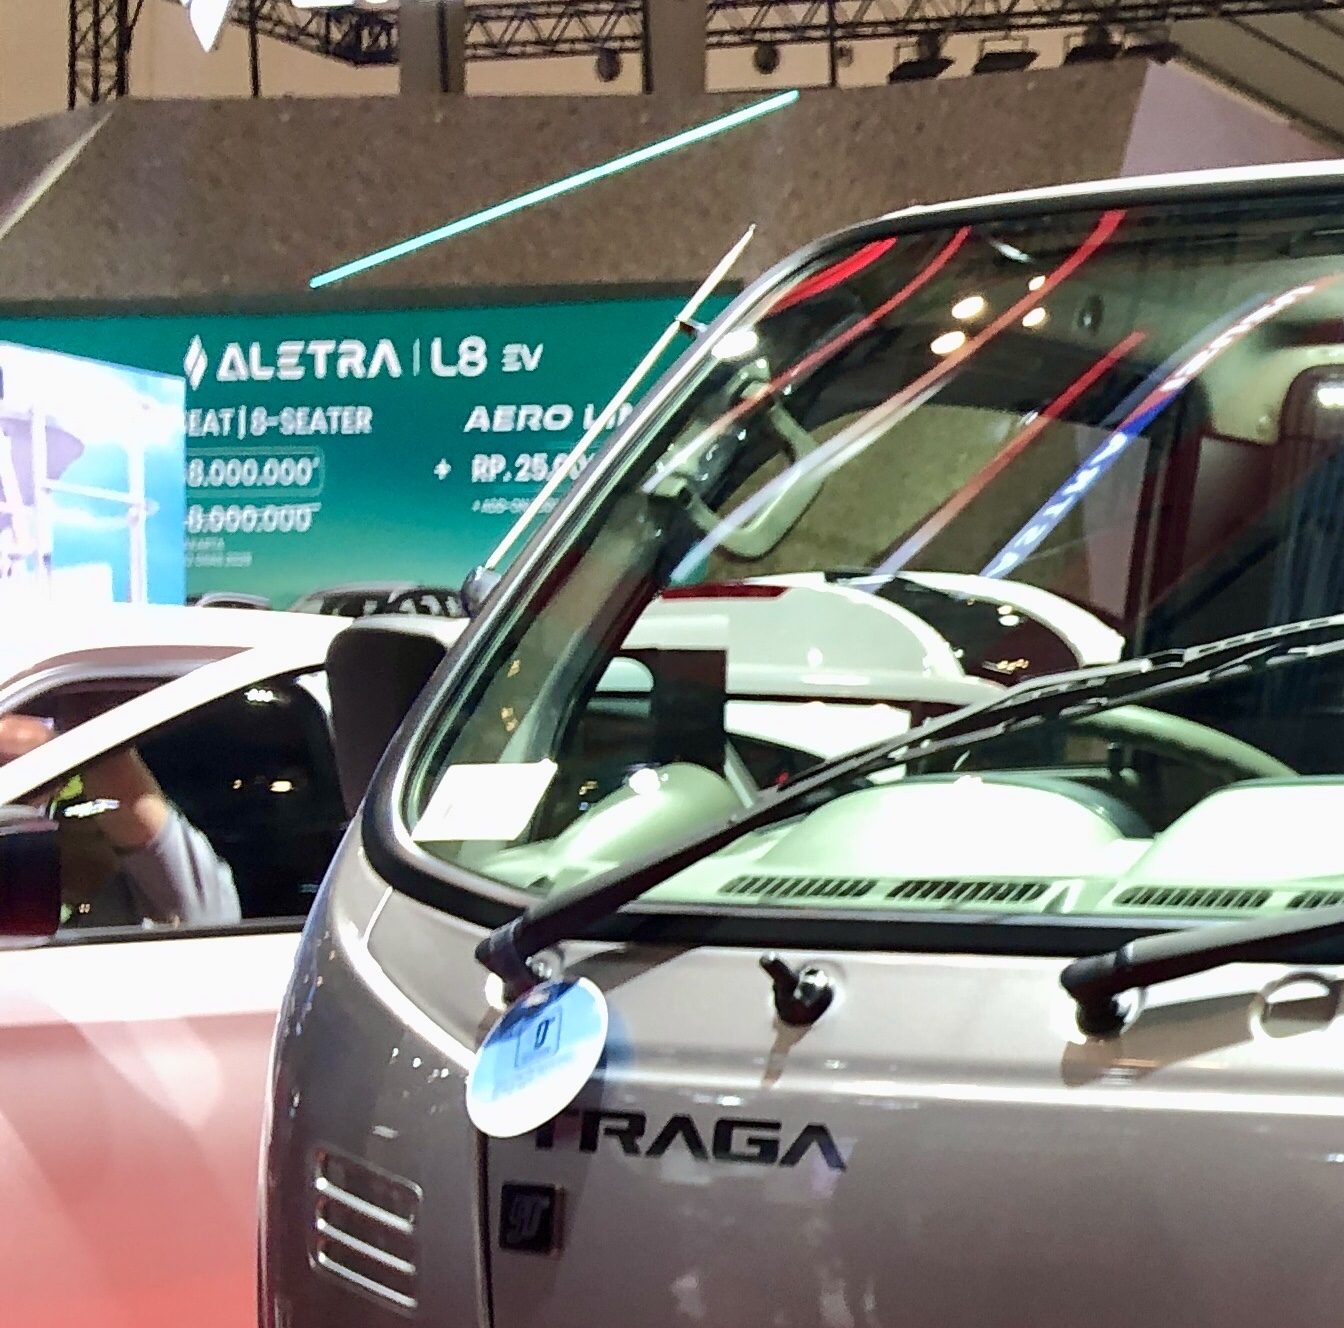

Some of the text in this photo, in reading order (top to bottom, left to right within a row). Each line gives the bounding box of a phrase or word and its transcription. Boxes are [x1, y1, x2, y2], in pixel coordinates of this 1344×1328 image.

[216, 335, 544, 382] ALETRA L8 EV
[463, 402, 575, 433] AERO
